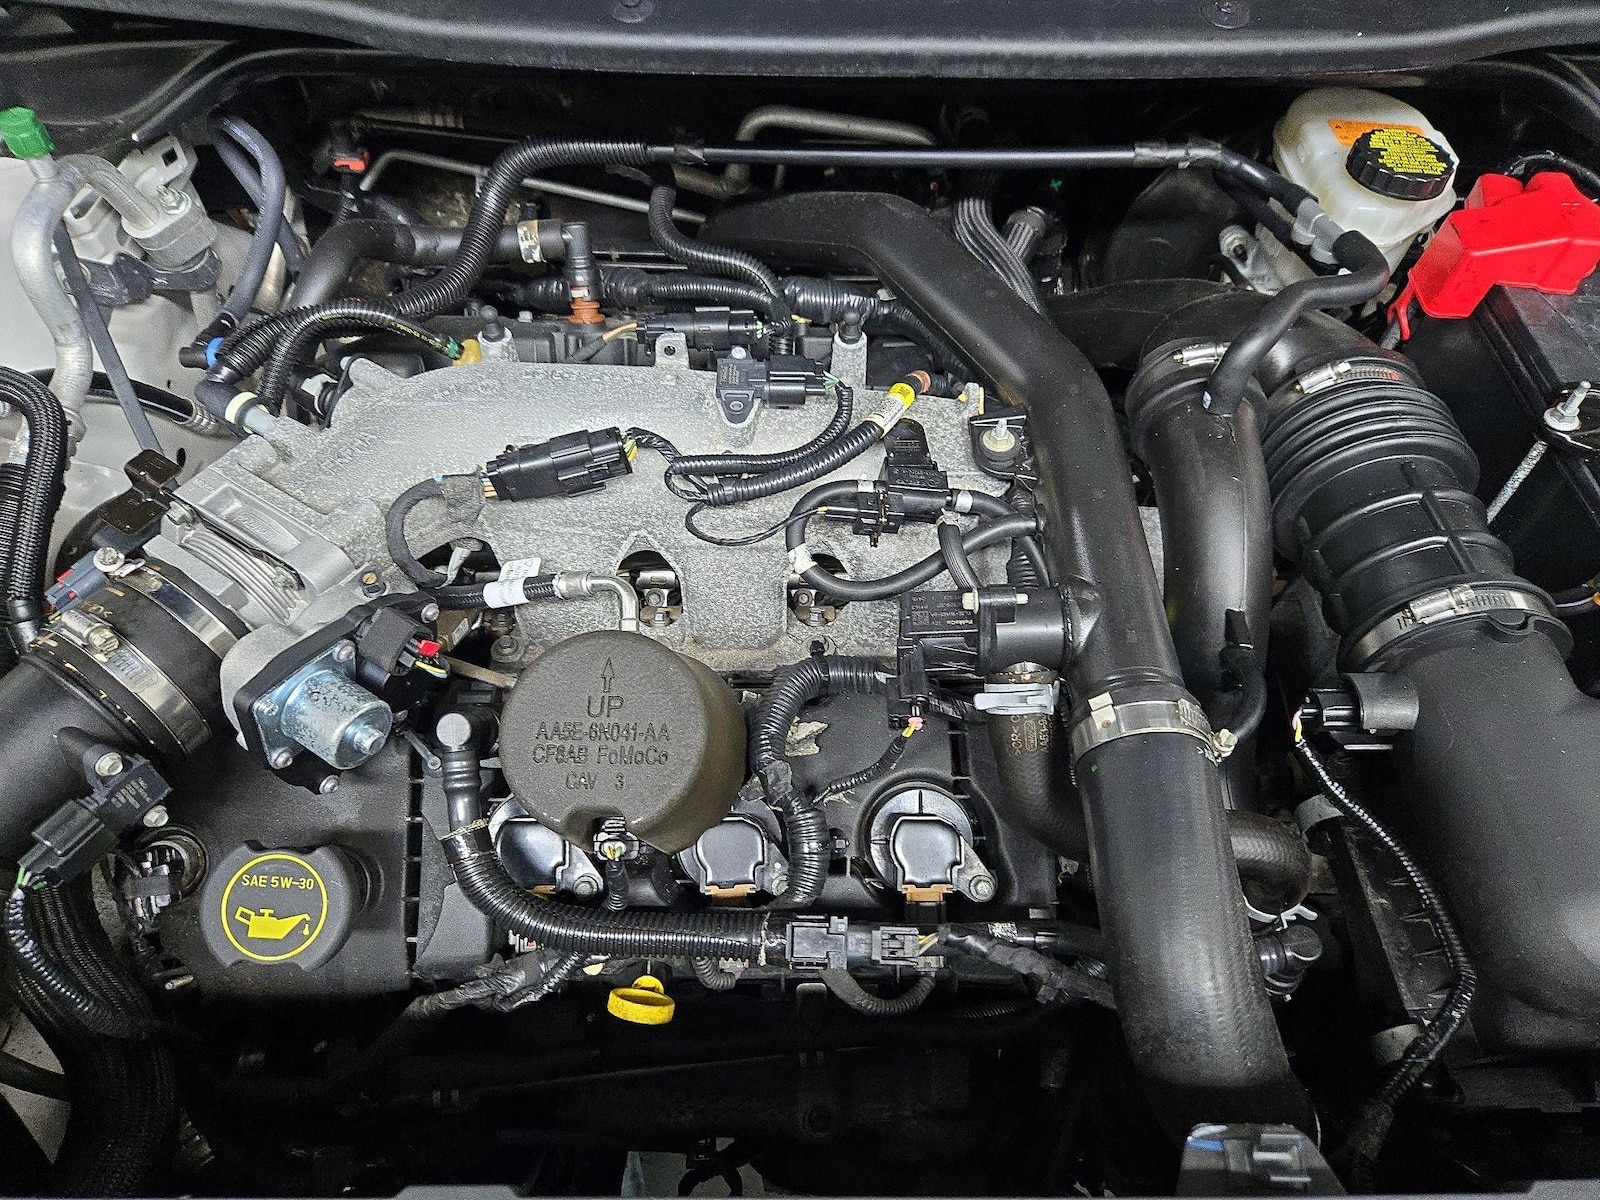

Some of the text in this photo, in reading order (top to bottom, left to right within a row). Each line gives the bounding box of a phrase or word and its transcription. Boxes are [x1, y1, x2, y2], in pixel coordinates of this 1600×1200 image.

[587, 695, 625, 718] UP
[535, 721, 672, 742] AA5E-6N041-AA
[597, 745, 669, 766] FoMoCo
[565, 771, 625, 791] CAV 3
[241, 874, 315, 890] SAE 5W-30
